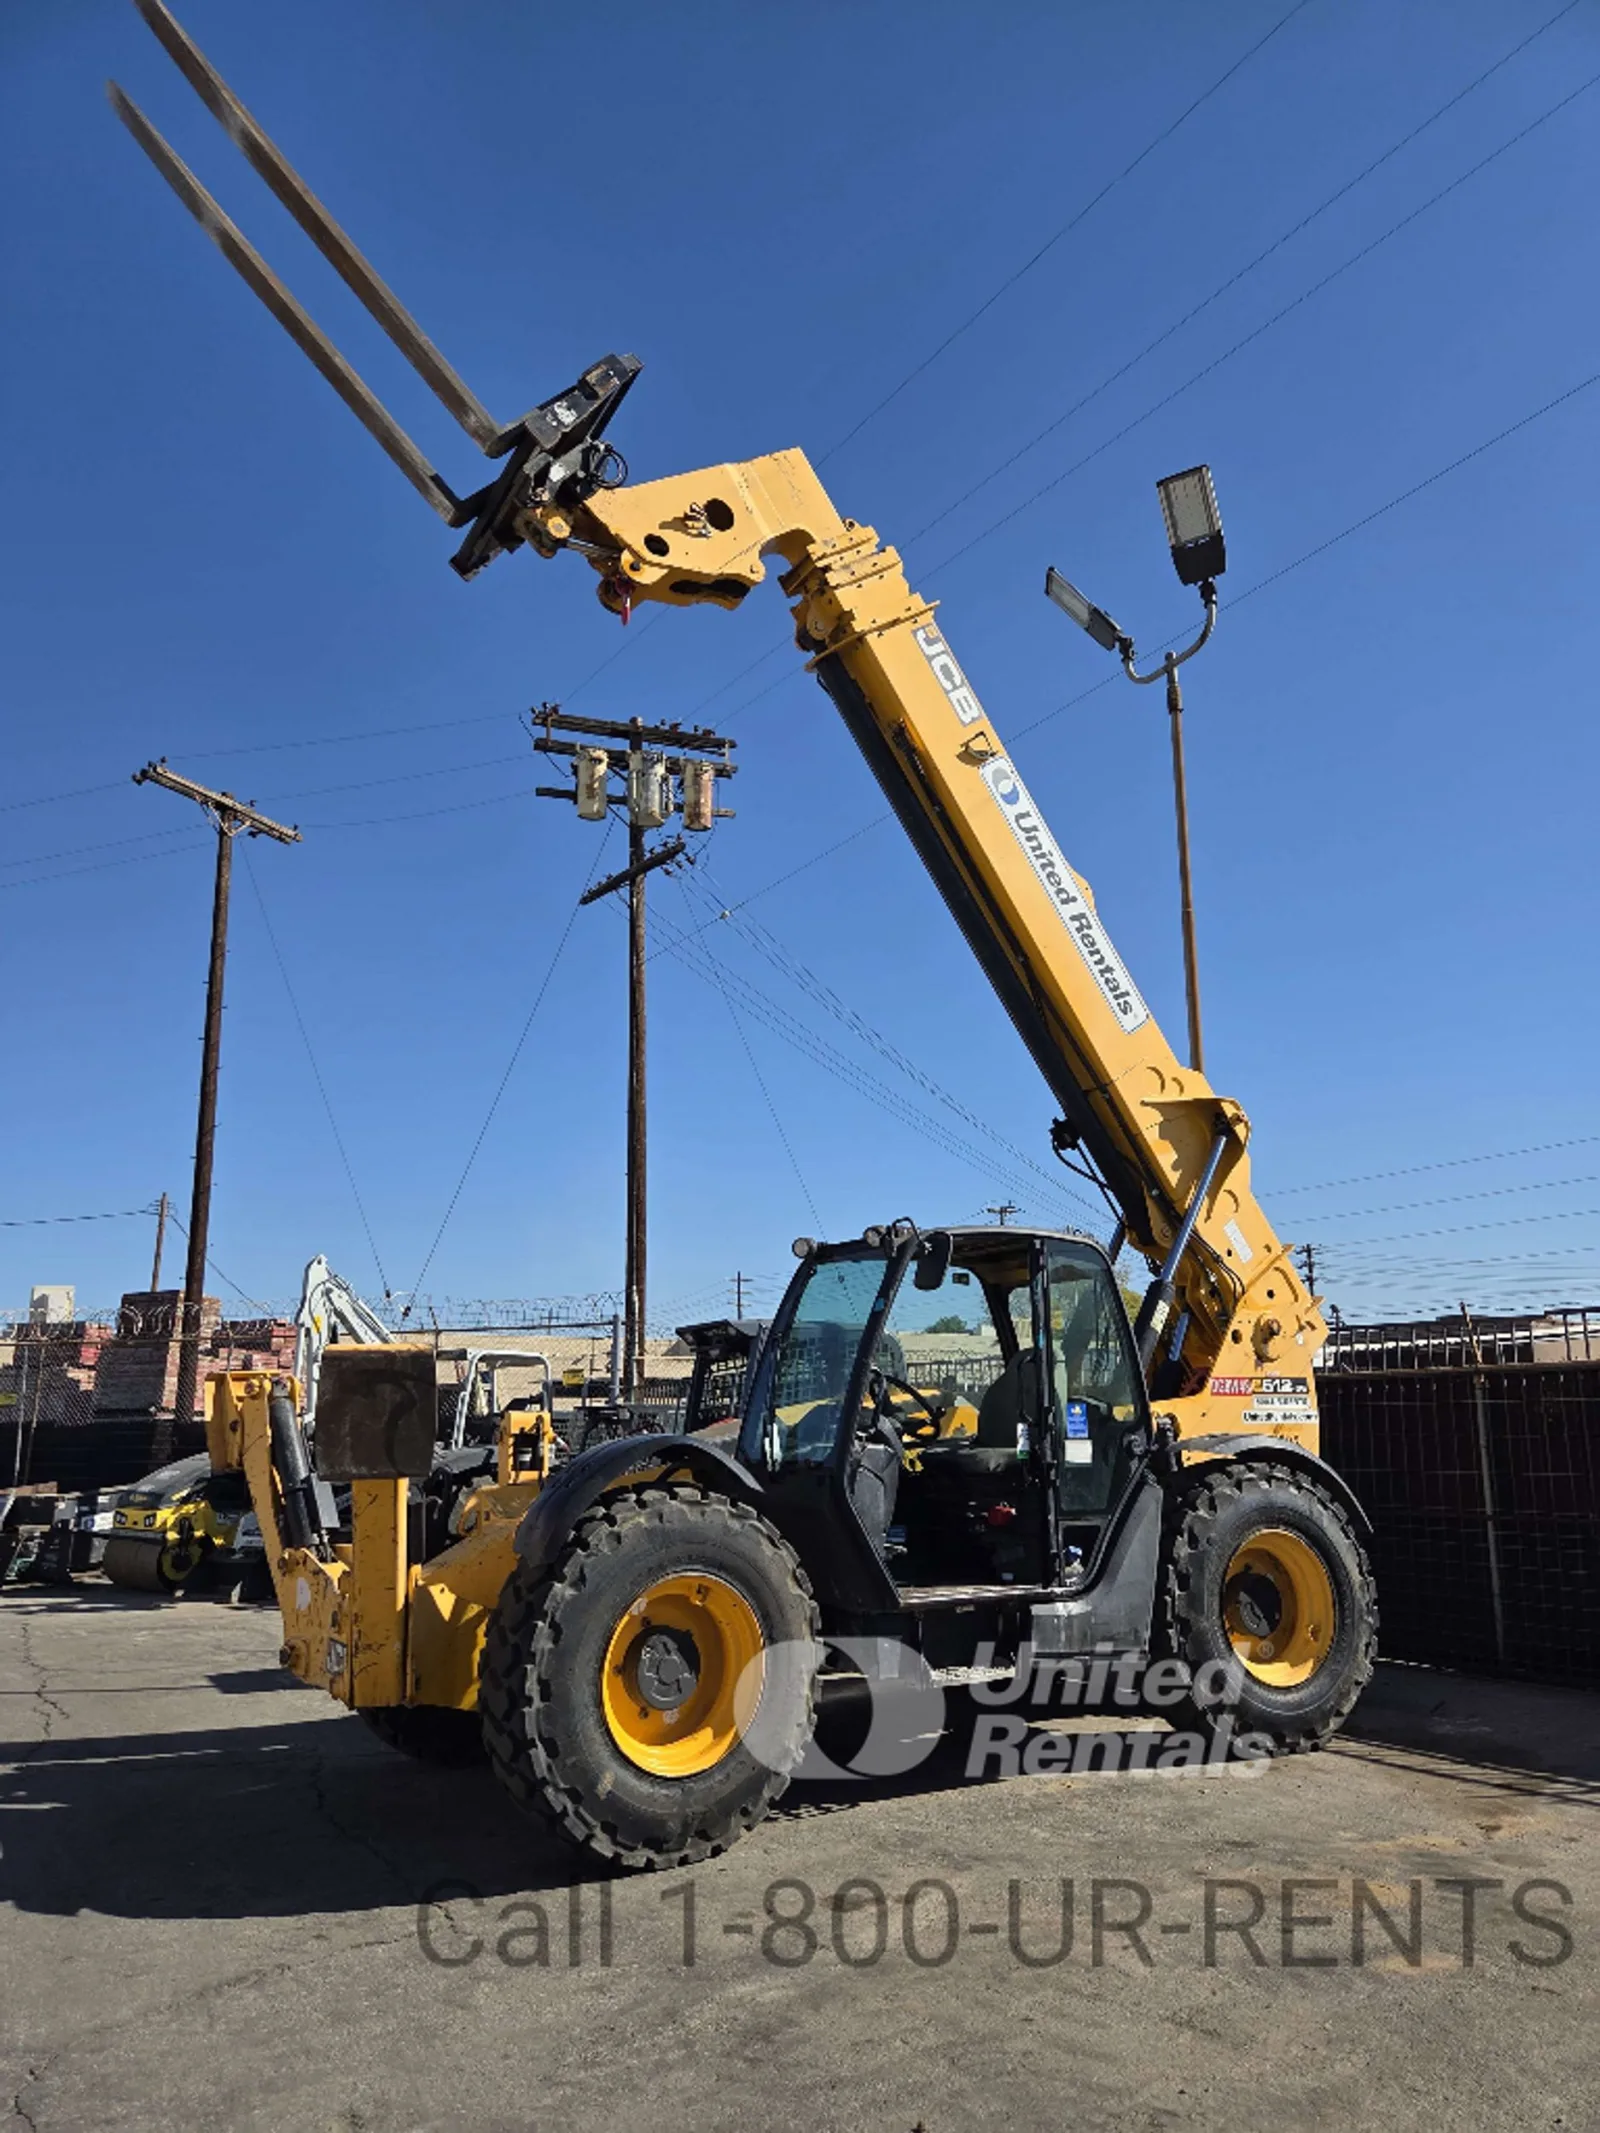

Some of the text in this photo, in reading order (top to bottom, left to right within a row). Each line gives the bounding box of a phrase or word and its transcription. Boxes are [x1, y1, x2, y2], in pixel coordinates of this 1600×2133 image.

[914, 628, 980, 724] JCB
[1014, 810, 1133, 1016] United Rentals
